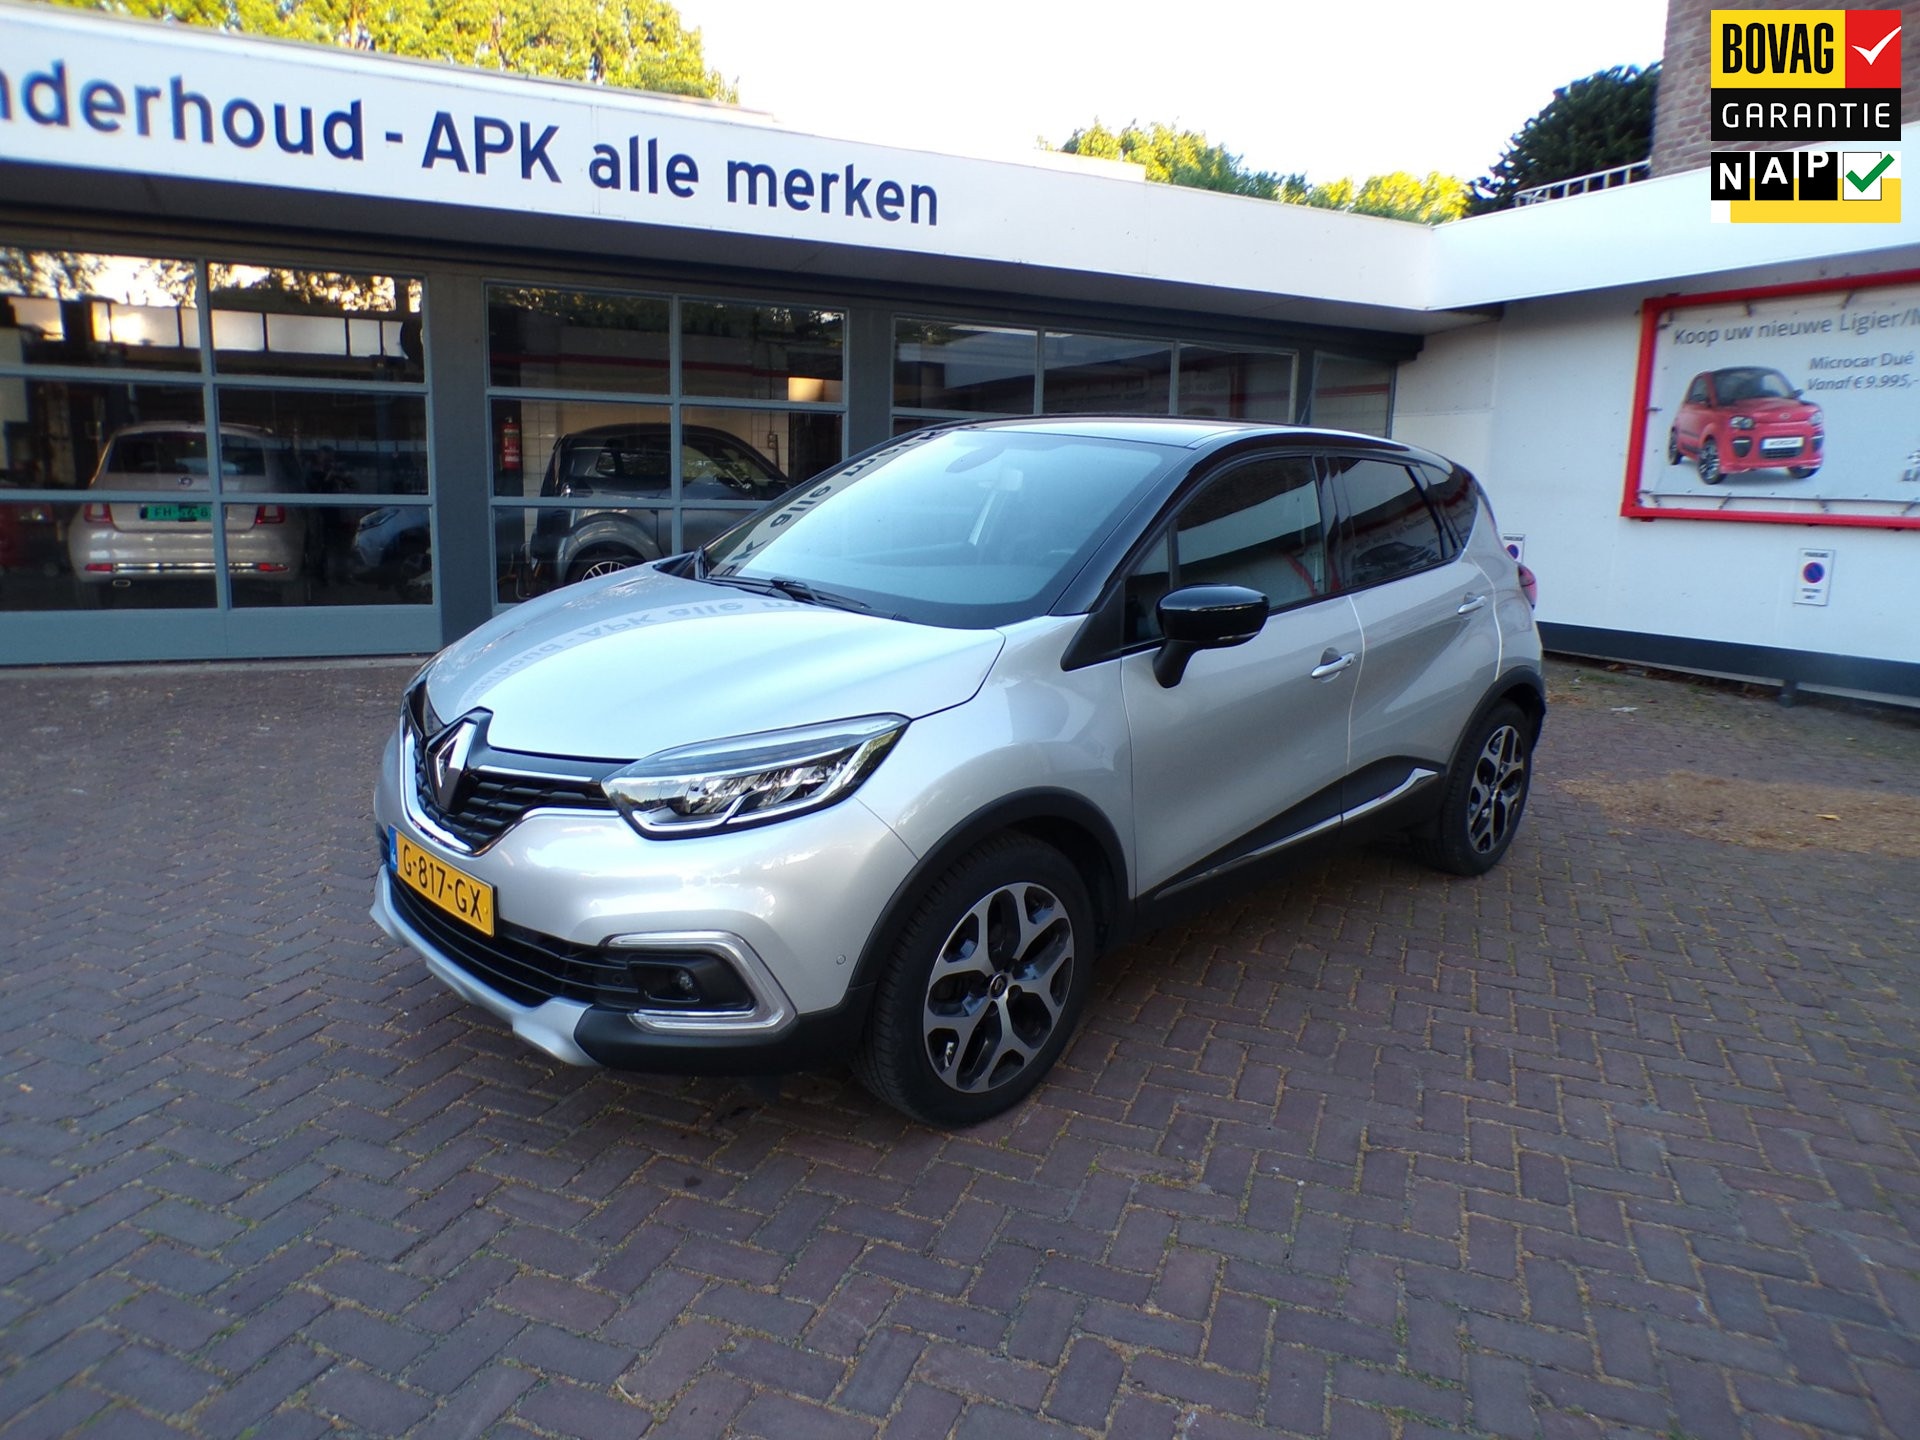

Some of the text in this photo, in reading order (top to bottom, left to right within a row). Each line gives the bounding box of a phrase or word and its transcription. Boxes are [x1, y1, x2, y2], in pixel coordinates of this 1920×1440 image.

[0, 59, 363, 161] derhoud
[421, 110, 562, 183] APK
[589, 135, 699, 198] alle
[727, 160, 938, 226] merken
[1673, 328, 1719, 347] Koop
[1724, 325, 1754, 341] uw
[1758, 318, 1832, 338] nieuwe
[1808, 350, 1914, 370] Microcar Dué
[1807, 376, 1853, 390] Vanaf
[403, 844, 482, 923] G-817-GX
